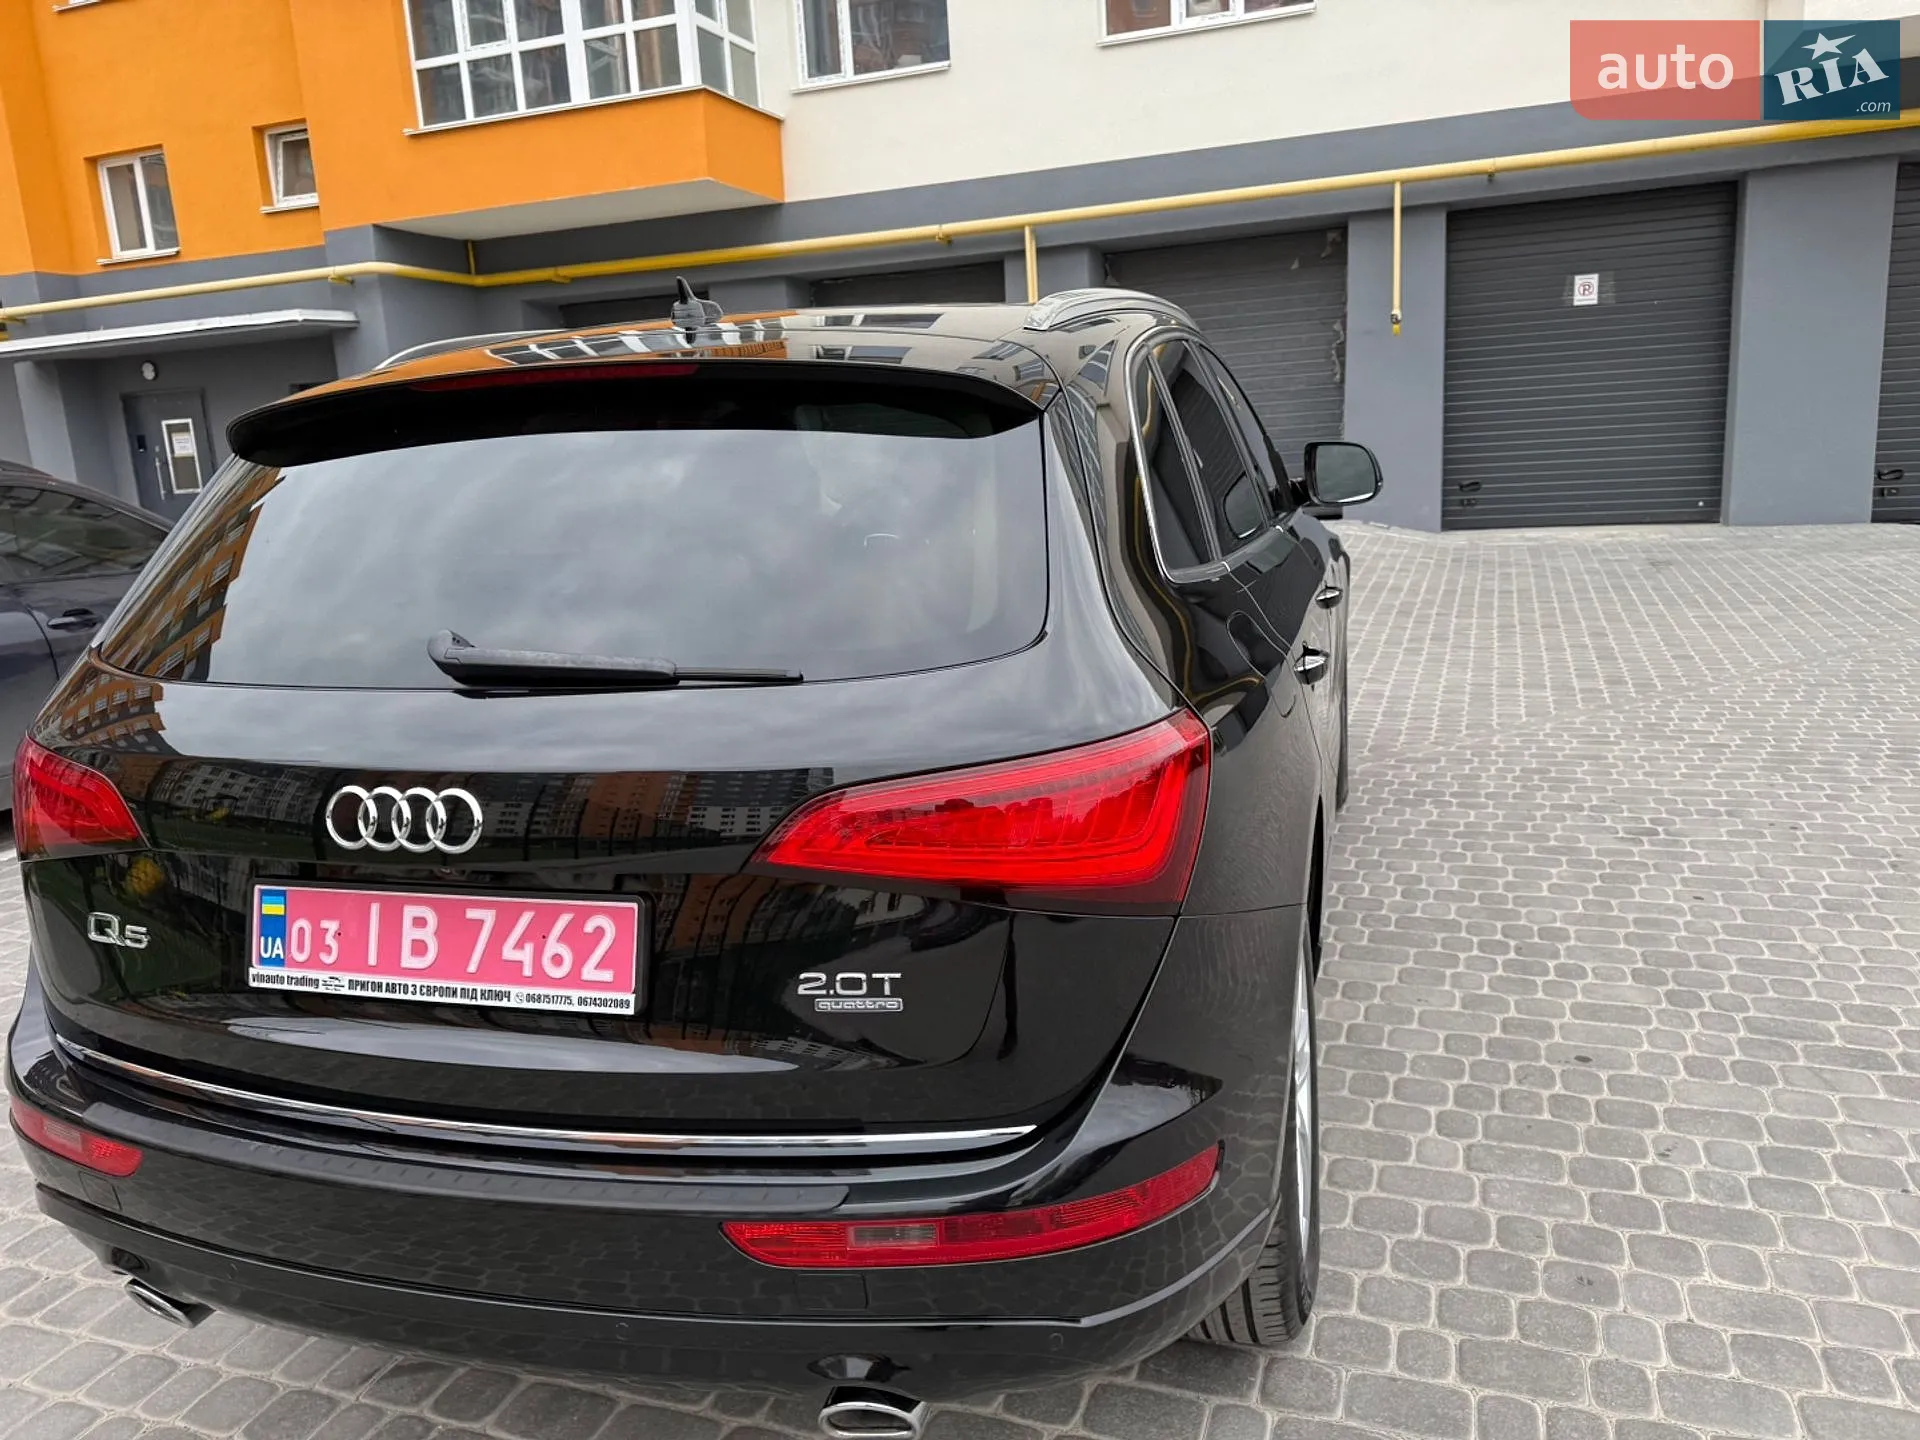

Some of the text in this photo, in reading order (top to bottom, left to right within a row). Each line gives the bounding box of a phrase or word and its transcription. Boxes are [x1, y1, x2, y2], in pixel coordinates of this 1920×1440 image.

[87, 911, 150, 949] Q5
[260, 936, 284, 959] UA
[290, 918, 341, 964] 03
[464, 907, 616, 983] 7462
[286, 975, 320, 989] trading
[348, 979, 384, 993] ПРИГОН
[385, 982, 409, 995] АВТО
[419, 985, 458, 999] ЄВРОПИ
[460, 987, 478, 1001] ПІД
[480, 989, 511, 1002] КЛЮЧ
[818, 1000, 899, 1011] quattro
